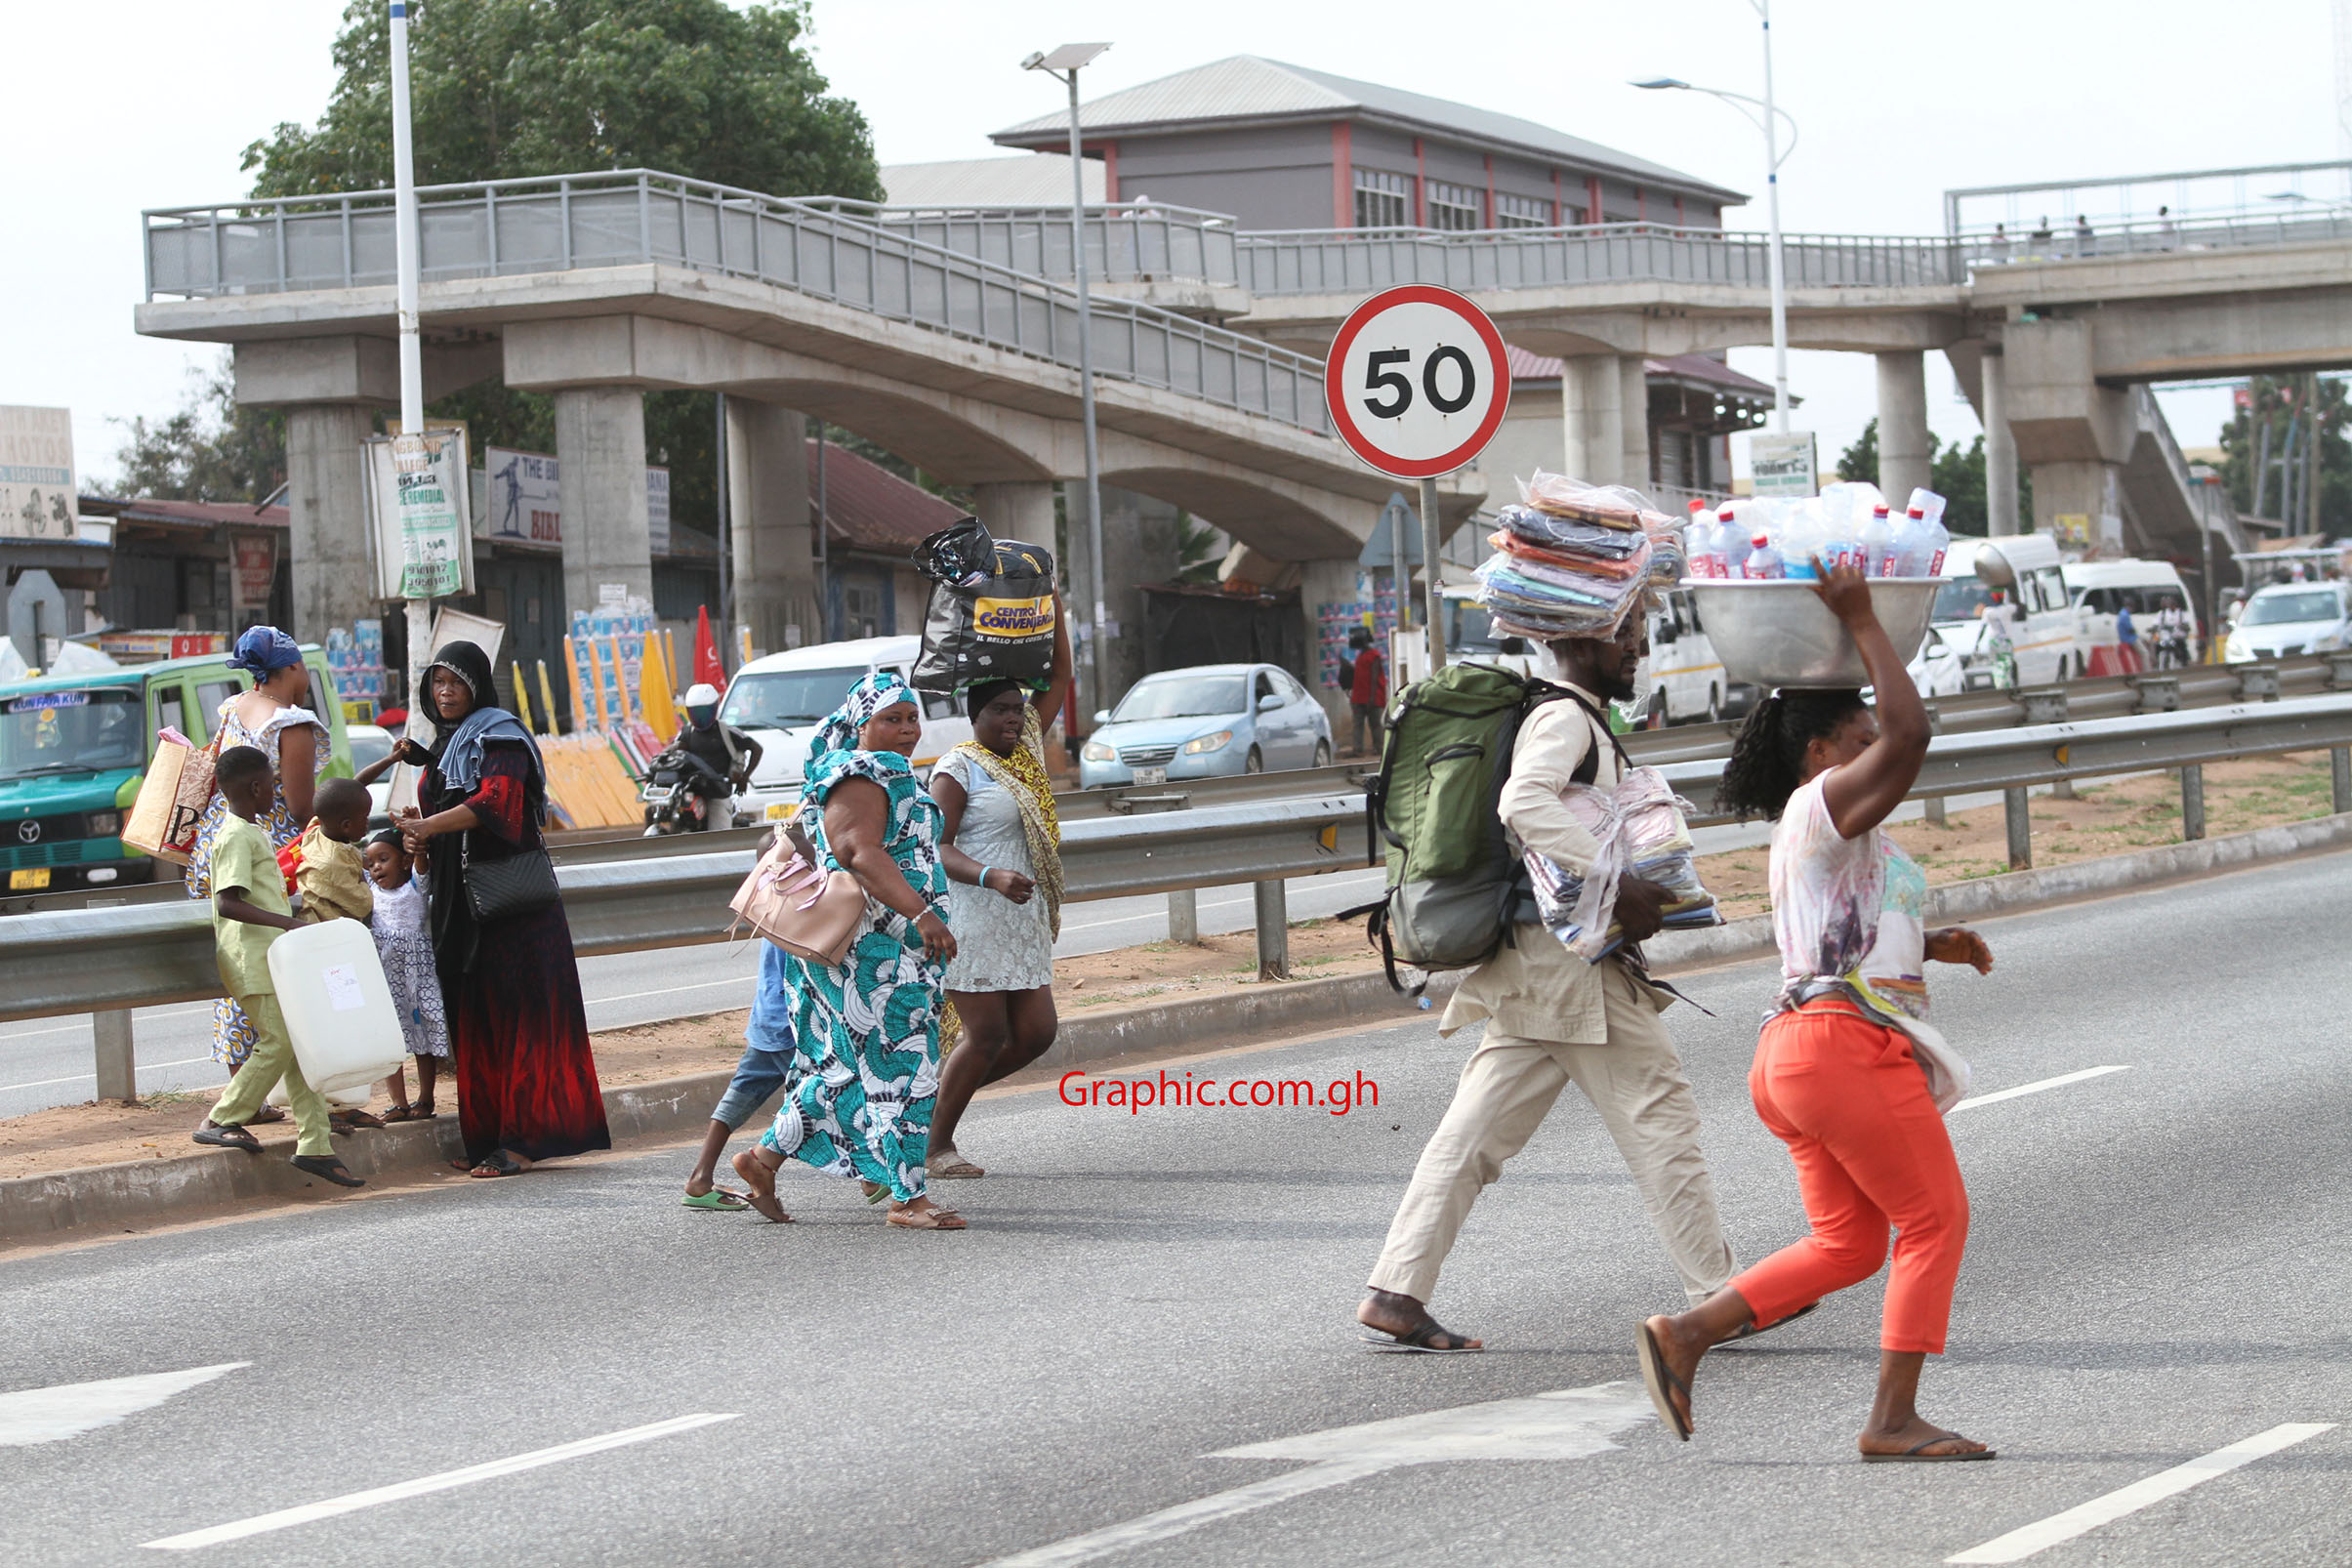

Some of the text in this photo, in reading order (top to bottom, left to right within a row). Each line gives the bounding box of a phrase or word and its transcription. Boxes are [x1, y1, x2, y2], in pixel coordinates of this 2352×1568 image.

[1363, 345, 1475, 419] 50
[0, 434, 68, 466] HOTOS
[521, 457, 543, 479] THE
[408, 488, 445, 505] REMEDIAL
[996, 607, 1036, 618] CENTRO
[986, 636, 1011, 644] BELLO
[14, 693, 85, 710] KUN FAYA KUN
